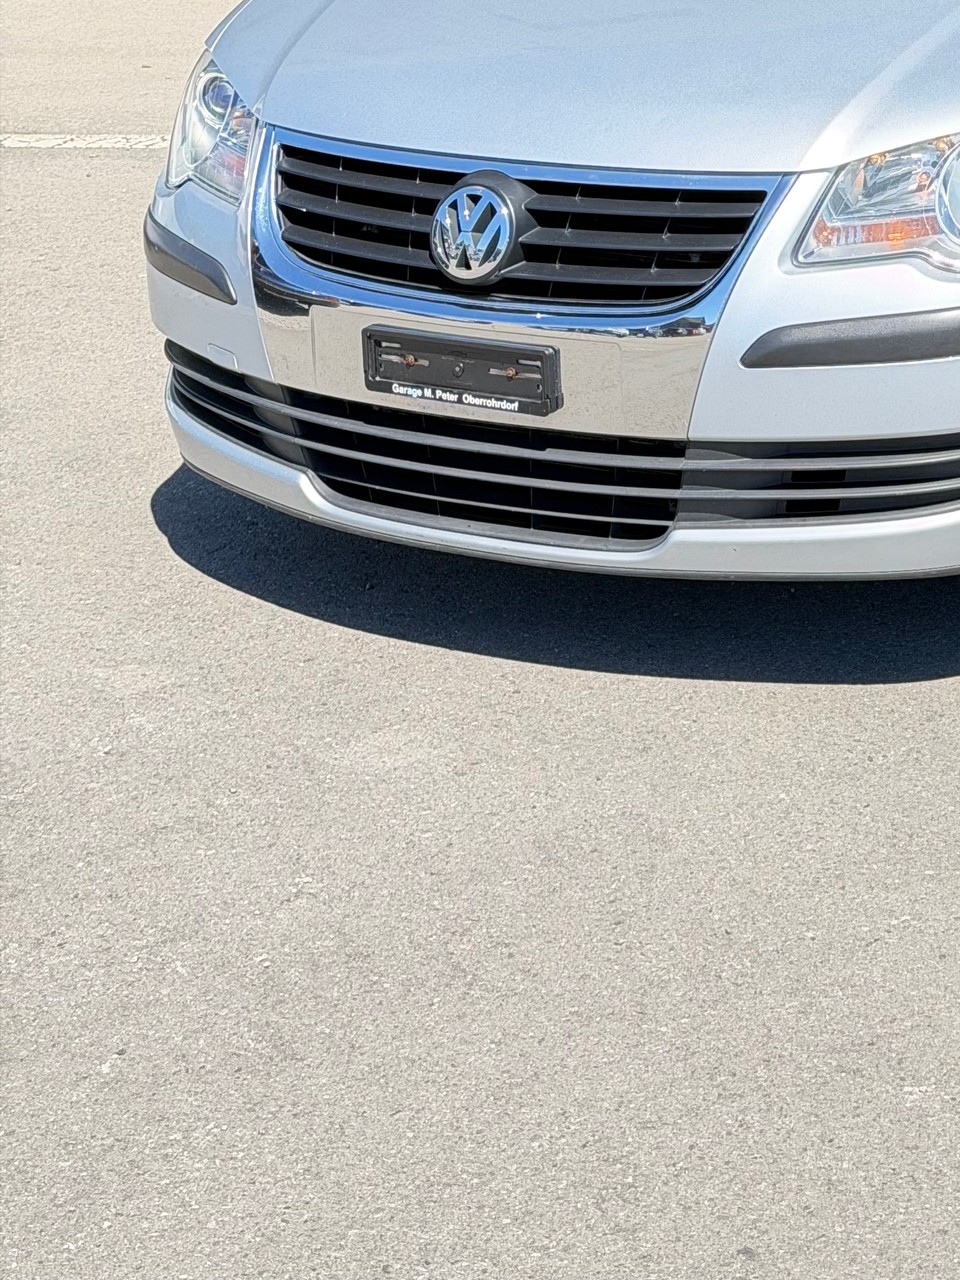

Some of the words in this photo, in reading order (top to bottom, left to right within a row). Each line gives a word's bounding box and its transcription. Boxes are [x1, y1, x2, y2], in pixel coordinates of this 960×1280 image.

[431, 185, 510, 280] VW
[392, 383, 422, 397] Garage
[424, 388, 434, 398] M.
[436, 390, 459, 402] Peter
[462, 393, 519, 411] Oberrohrdorf
